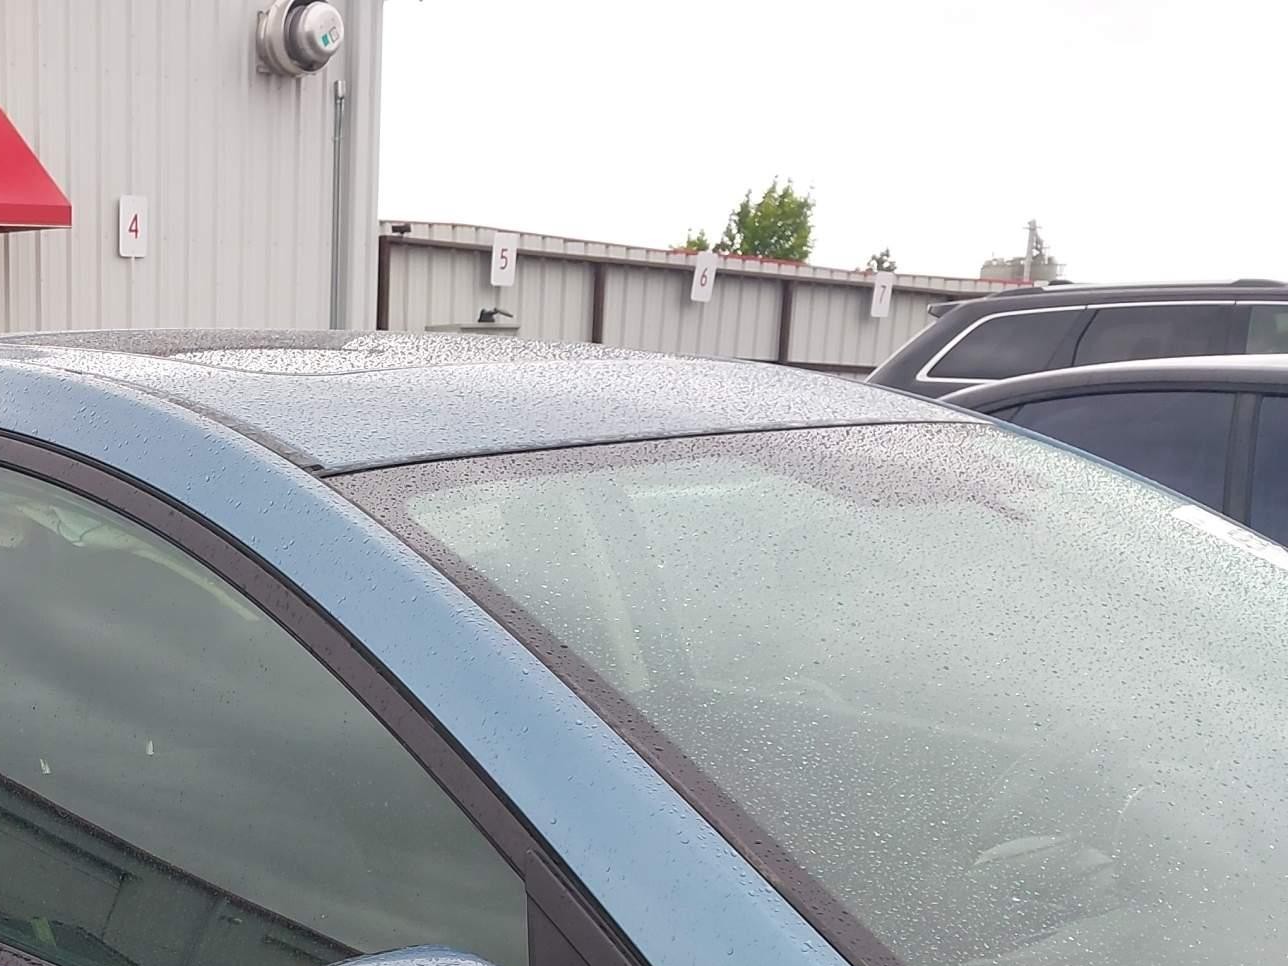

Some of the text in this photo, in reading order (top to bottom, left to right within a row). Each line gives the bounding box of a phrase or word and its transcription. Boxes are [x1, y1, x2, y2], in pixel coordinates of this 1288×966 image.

[128, 213, 139, 239] 4
[499, 248, 509, 271] 5
[700, 267, 709, 287] 6
[879, 284, 888, 304] 7
